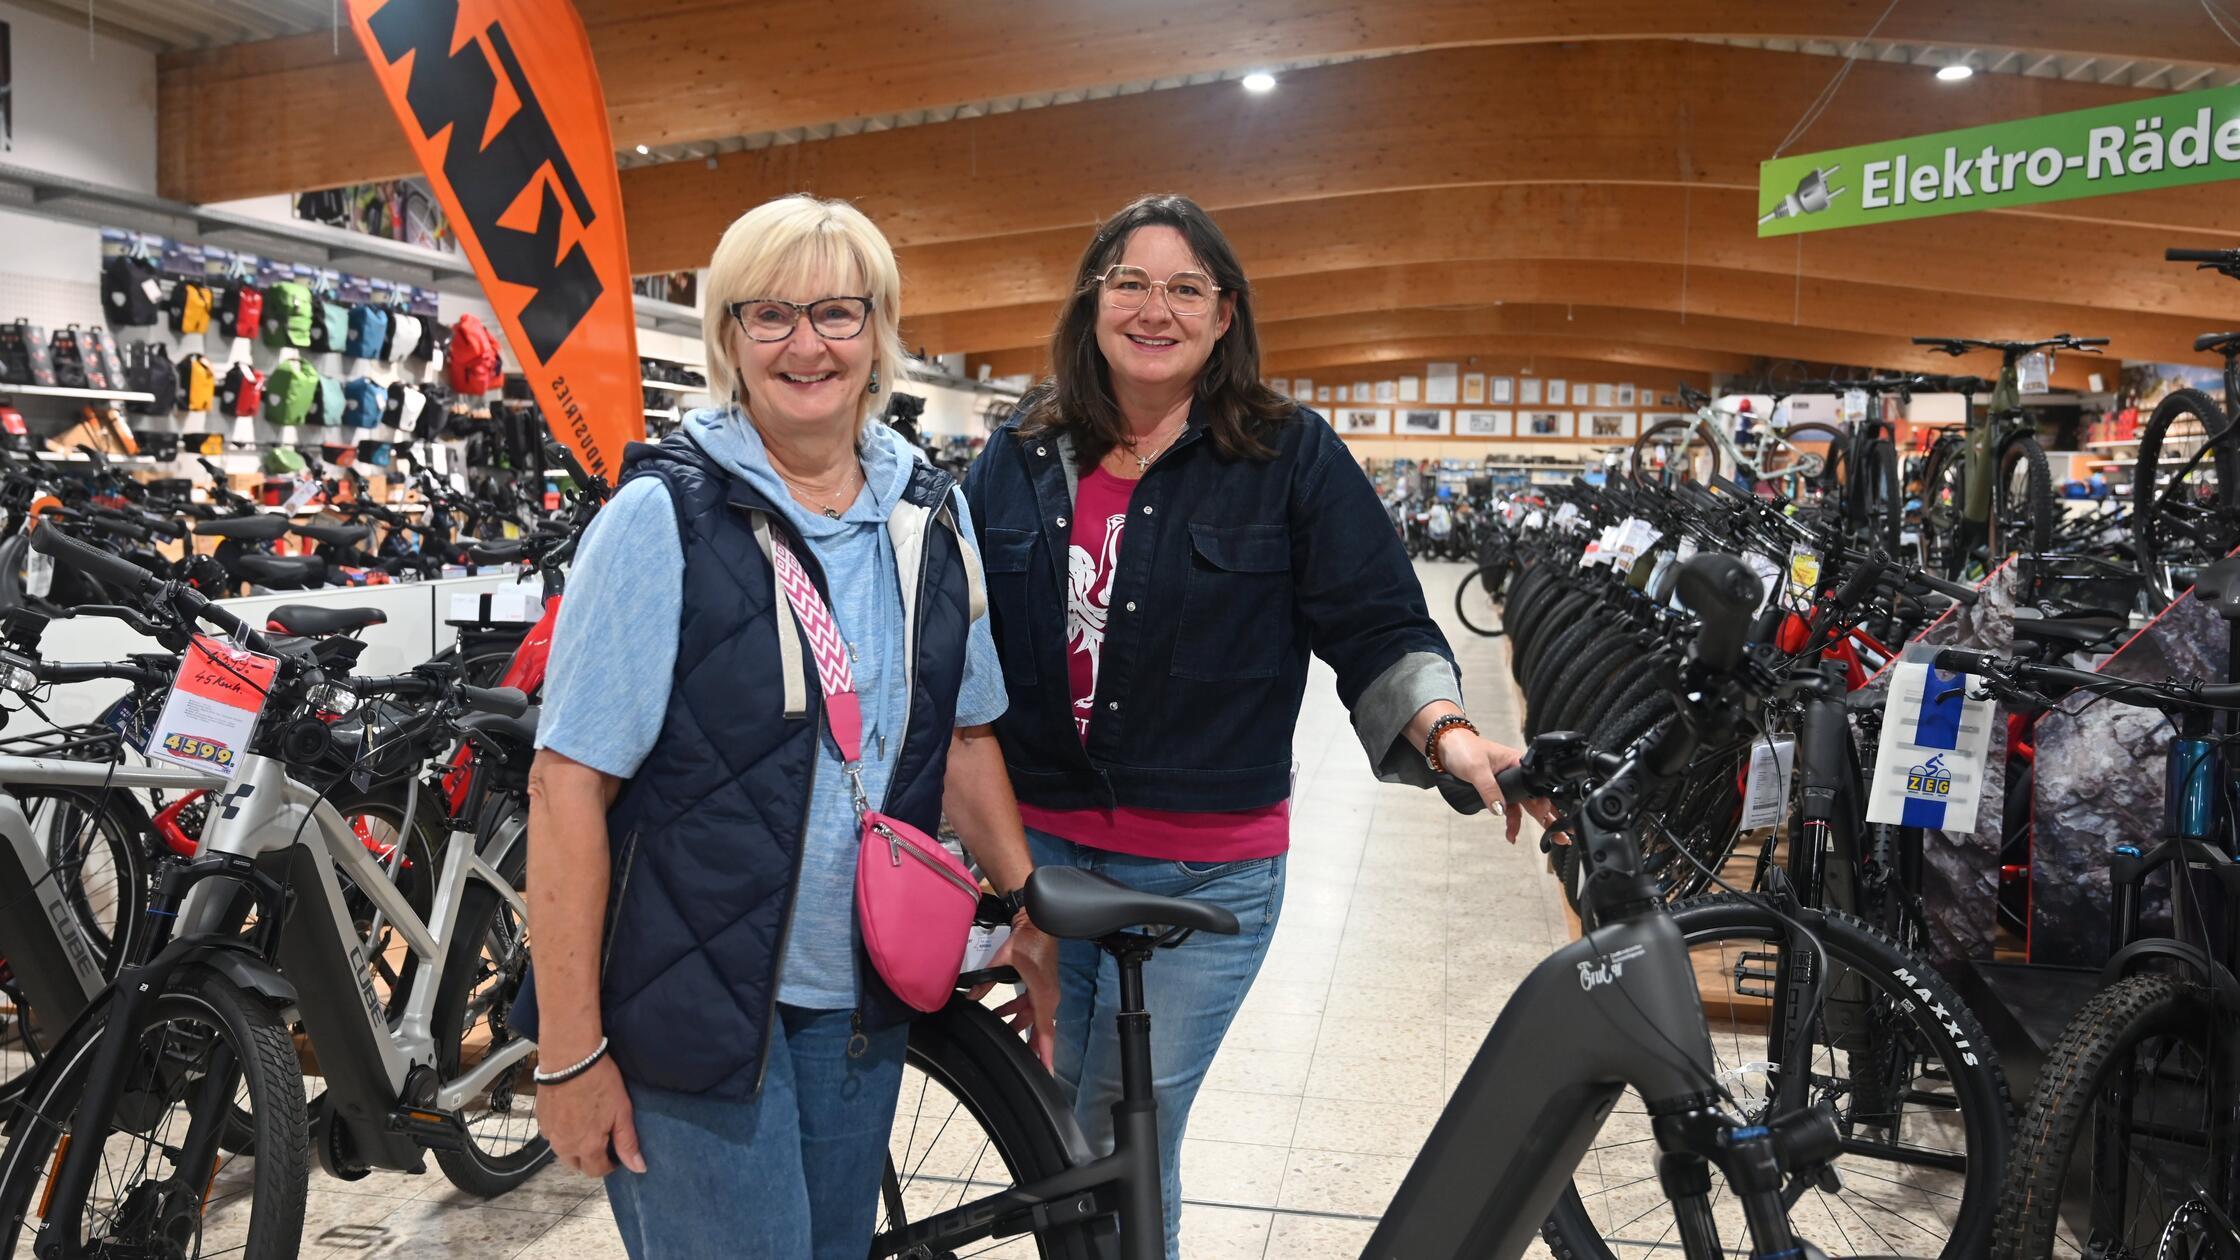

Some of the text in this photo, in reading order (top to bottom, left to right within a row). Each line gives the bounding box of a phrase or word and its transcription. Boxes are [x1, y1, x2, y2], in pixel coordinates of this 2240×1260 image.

[1907, 776, 1950, 794] ZEG
[49, 898, 95, 978] CUBE
[350, 945, 384, 1029] CUBE
[1892, 967, 1979, 1067] MAXXIS
